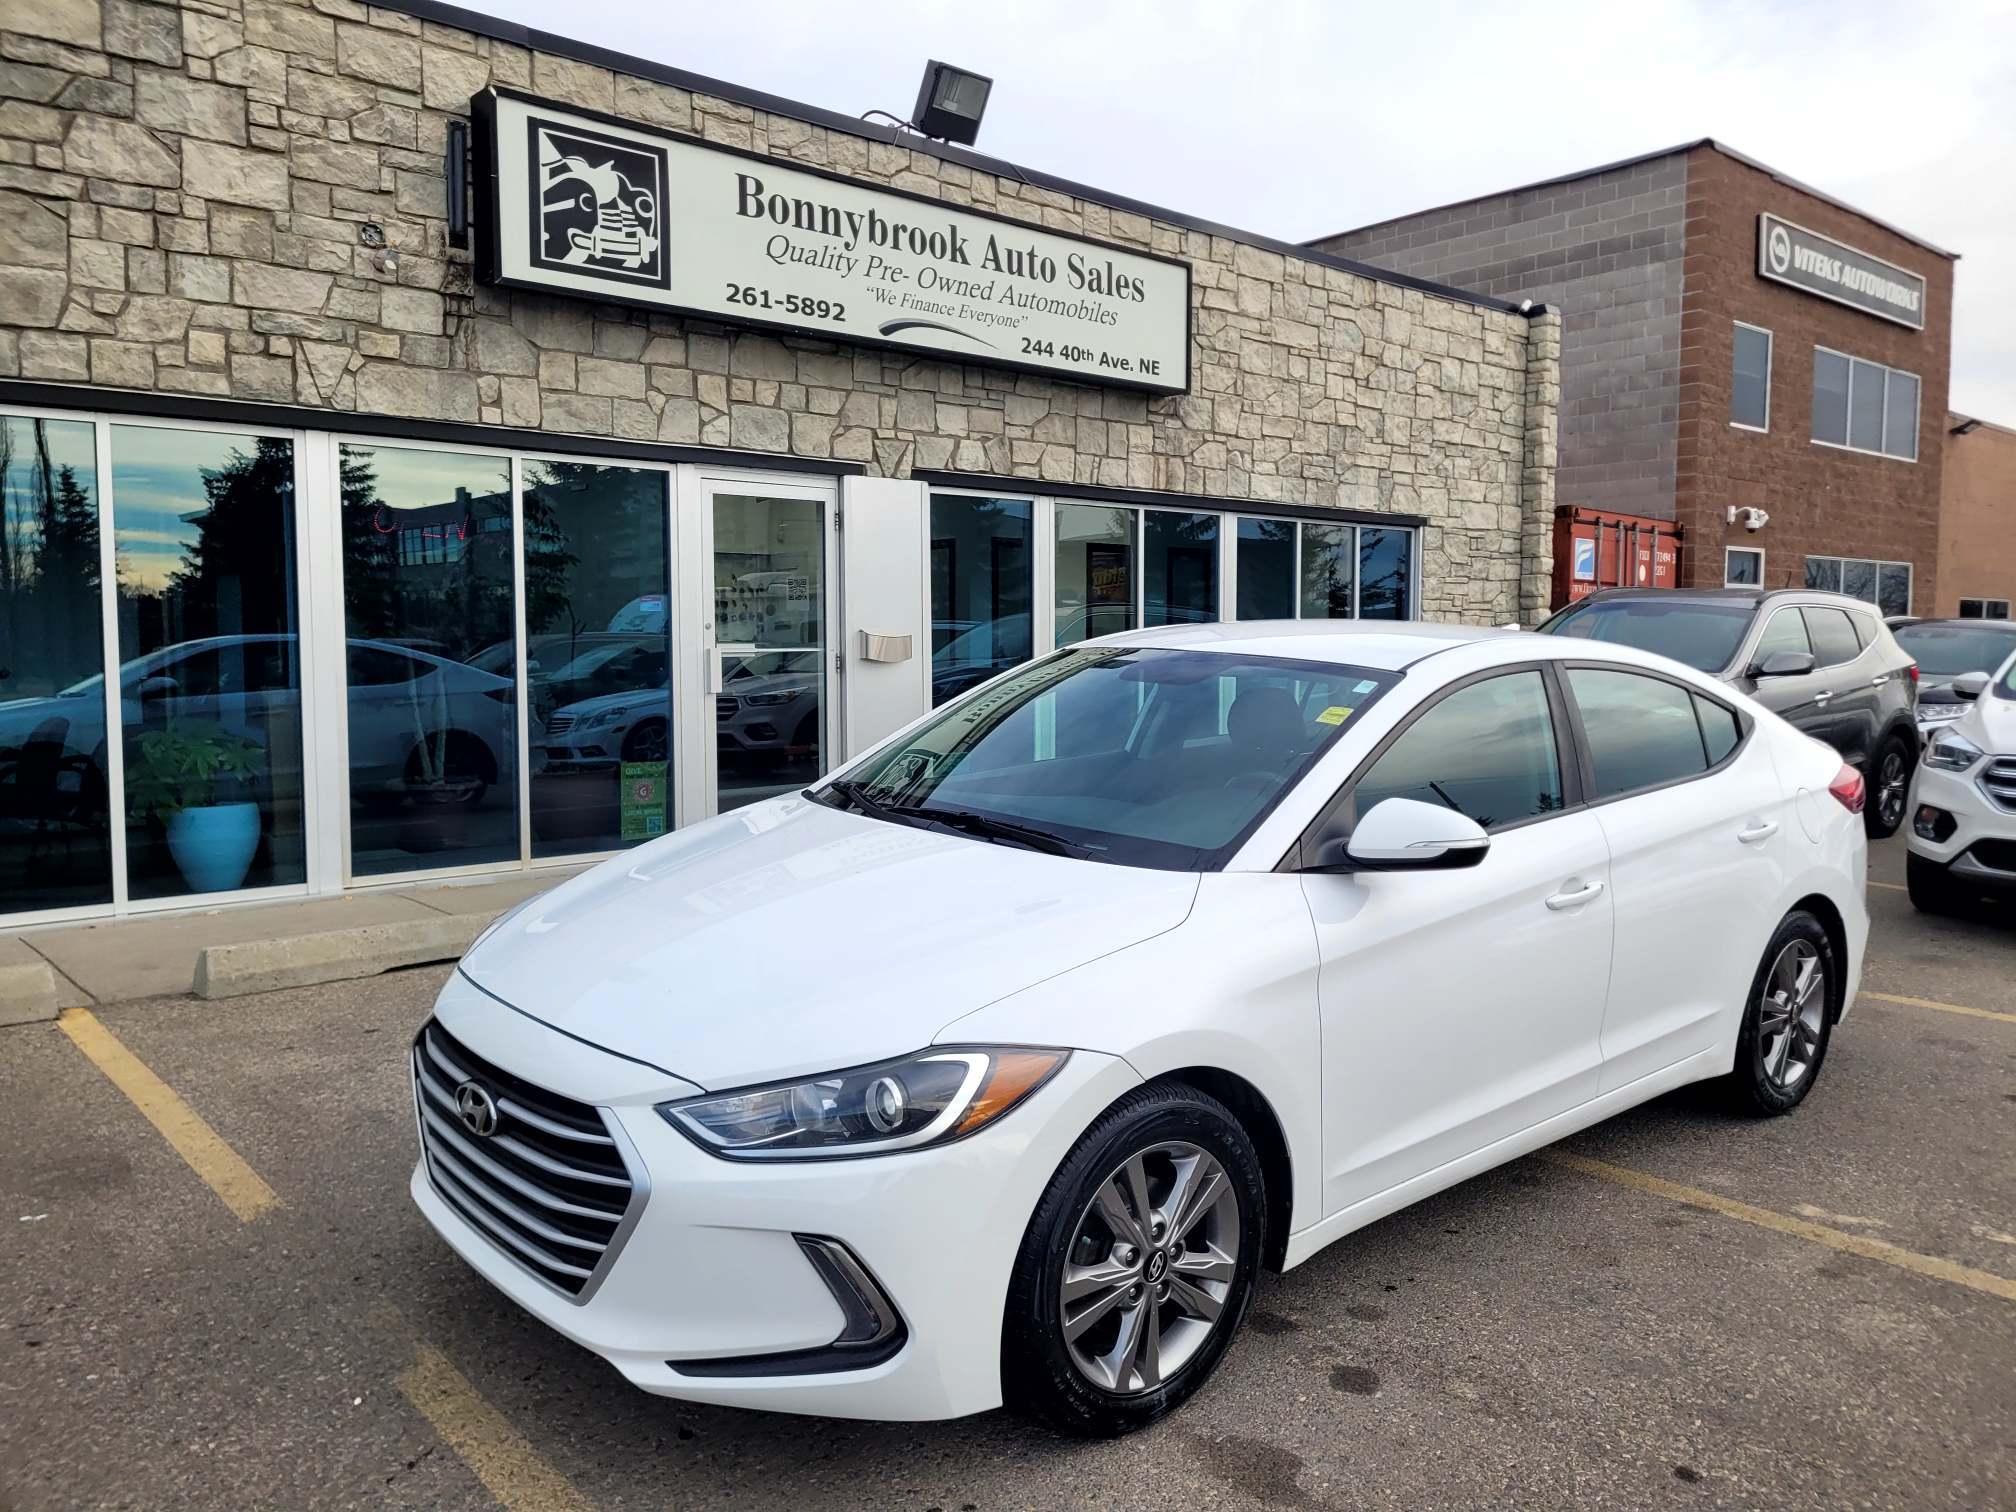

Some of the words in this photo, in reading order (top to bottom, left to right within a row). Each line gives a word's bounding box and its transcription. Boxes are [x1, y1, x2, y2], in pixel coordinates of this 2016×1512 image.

[735, 172, 971, 266] Bonnybrook
[981, 233, 1057, 284] Auto
[1067, 252, 1145, 303] Sales
[766, 234, 859, 278] Quality
[864, 254, 910, 283] Pre-
[917, 266, 995, 301] Owned
[1000, 284, 1119, 326] Automobiles
[1840, 264, 1920, 311] AUTOWORKS
[726, 283, 847, 322] 261-5892
[901, 292, 956, 316] Finance
[1021, 337, 1054, 358] 244
[1059, 345, 1094, 363] 40th
[1099, 351, 1134, 372] Ave.
[1139, 358, 1161, 376] NE
